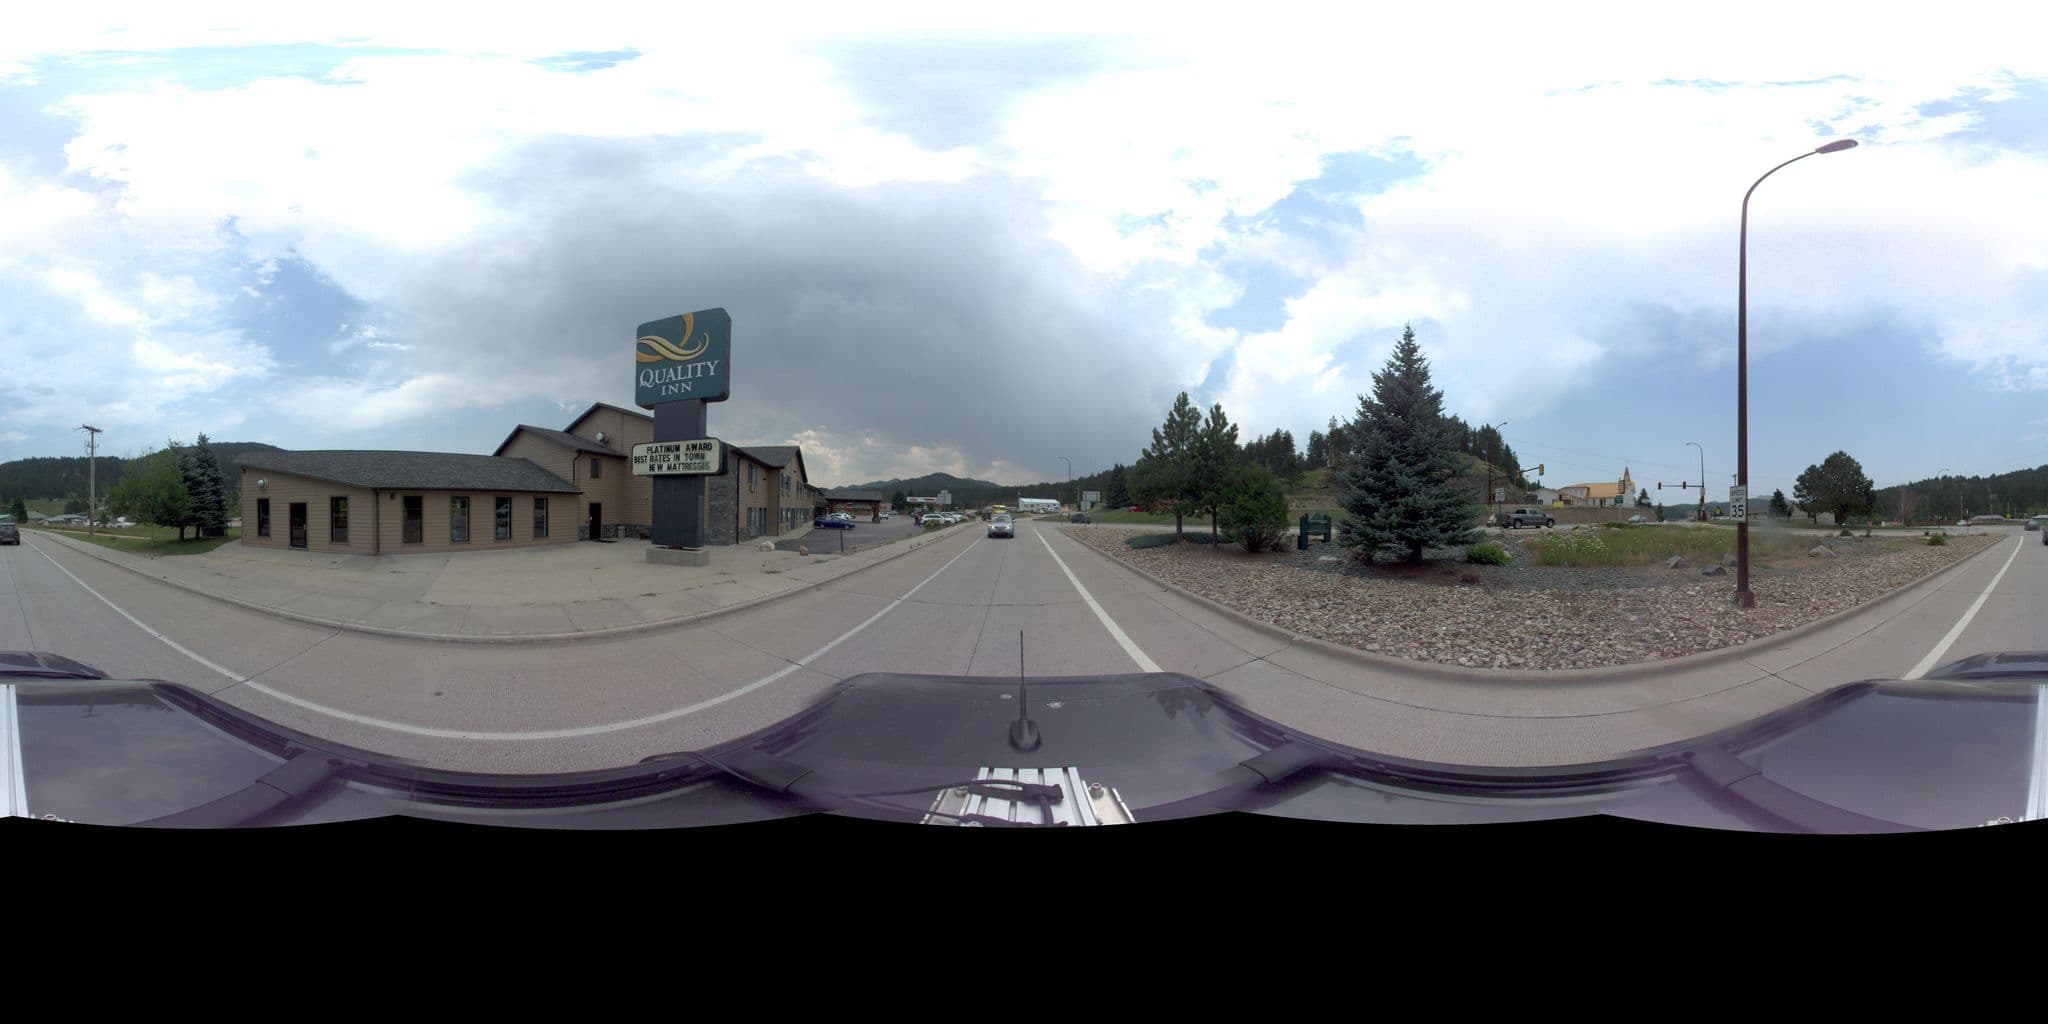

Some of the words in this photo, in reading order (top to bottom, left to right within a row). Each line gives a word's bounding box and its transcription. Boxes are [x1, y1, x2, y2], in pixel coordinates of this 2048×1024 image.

[640, 360, 719, 387] QUALITY
[661, 382, 693, 395] INN
[647, 445, 680, 454] PLATINUM
[686, 442, 713, 451] AWARD
[650, 454, 671, 463] RATES
[684, 452, 705, 461] TOWN
[649, 463, 663, 472] NEW
[1732, 505, 1744, 517] 35
